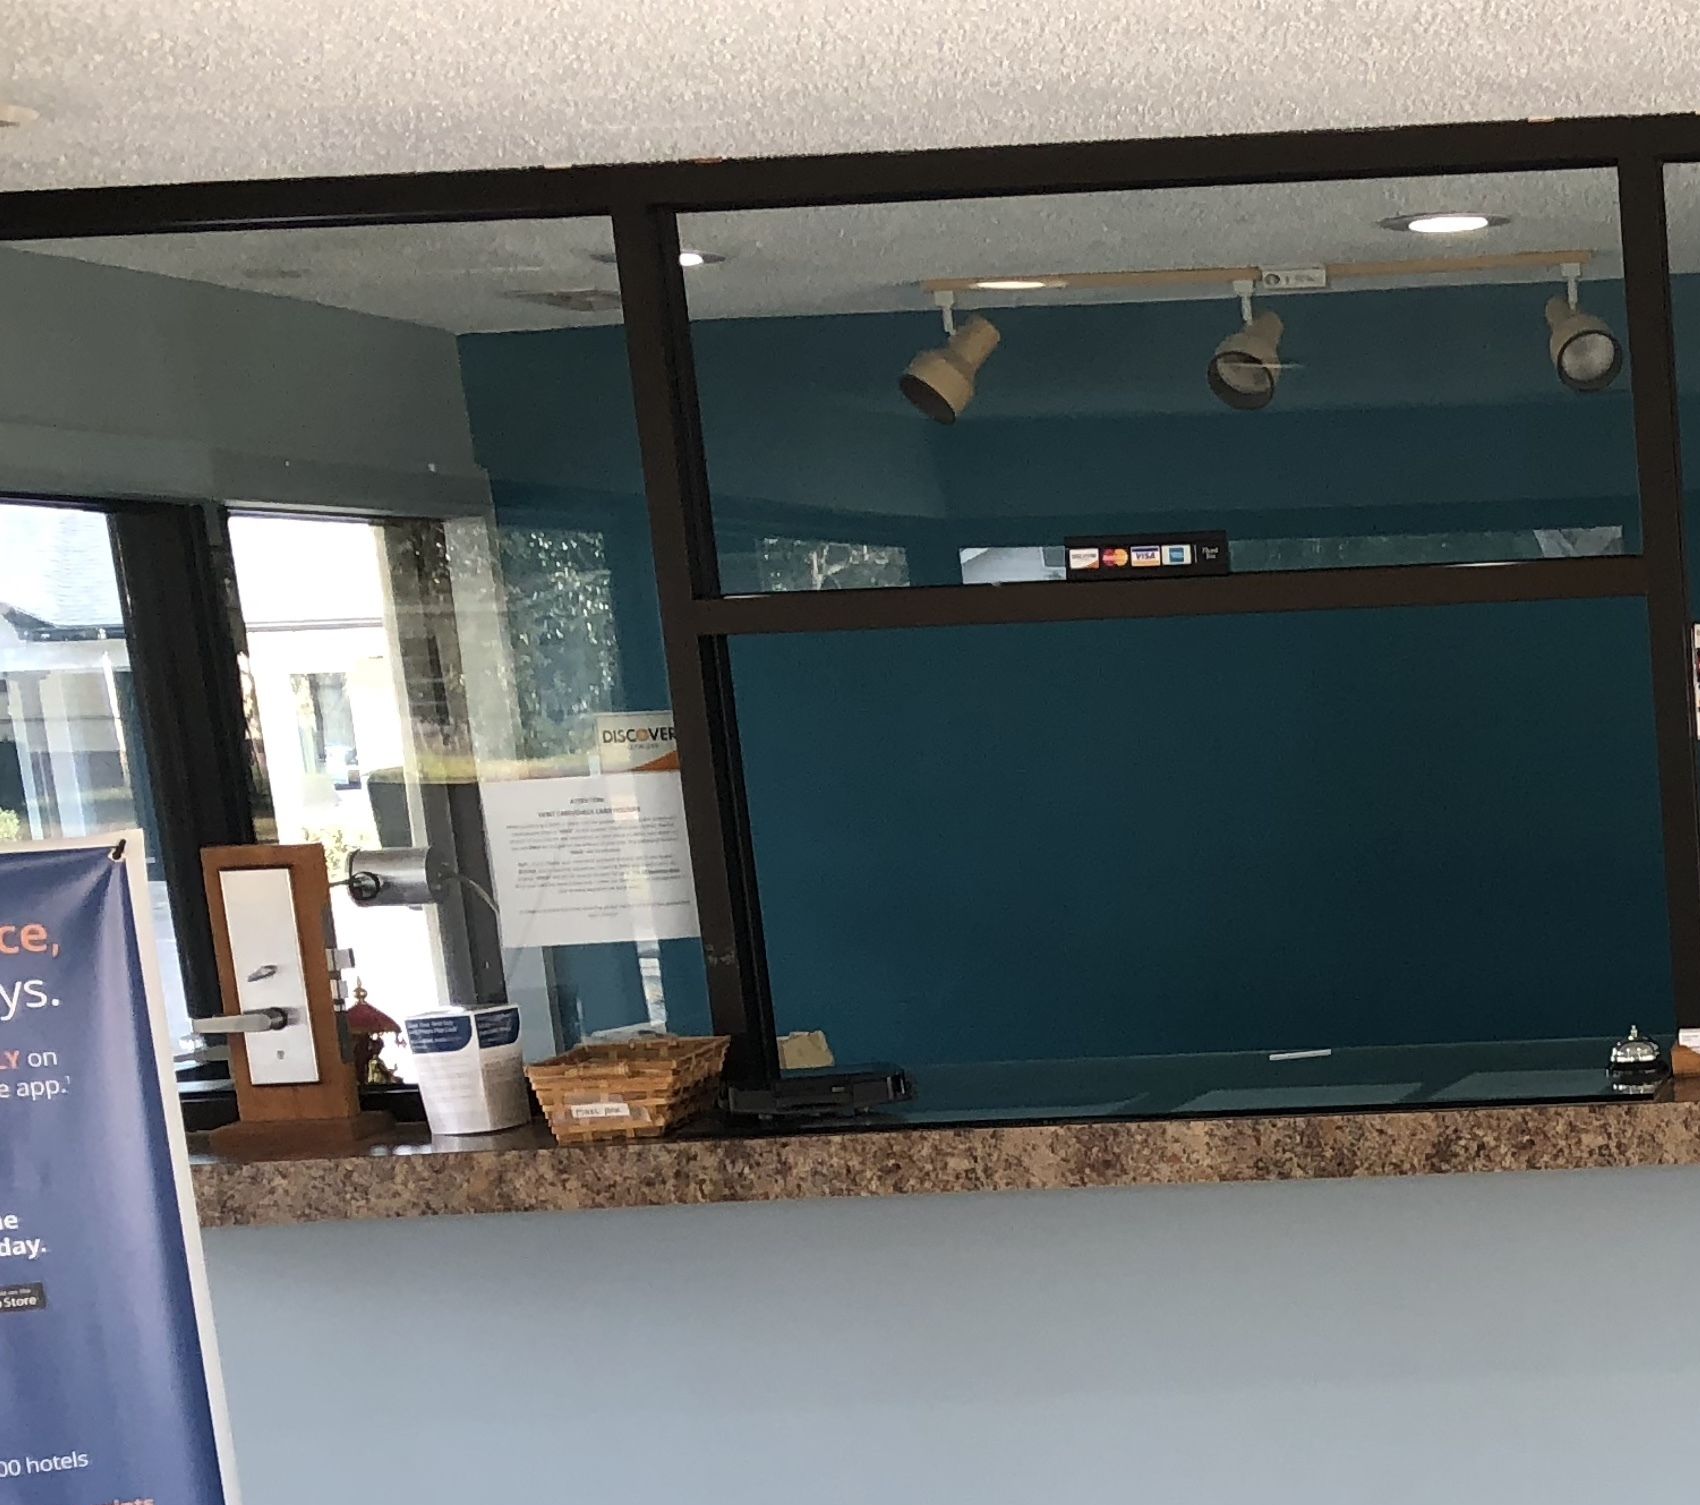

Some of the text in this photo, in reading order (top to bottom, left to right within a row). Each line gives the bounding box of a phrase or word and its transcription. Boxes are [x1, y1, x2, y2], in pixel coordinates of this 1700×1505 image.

[1136, 552, 1156, 560] VISA
[602, 727, 676, 743] DISCOVER
[0, 979, 60, 1021] ys.
[28, 1051, 58, 1068] on
[0, 1214, 19, 1230] e
[4, 1296, 37, 1308] Store
[26, 1451, 89, 1475] hotels
